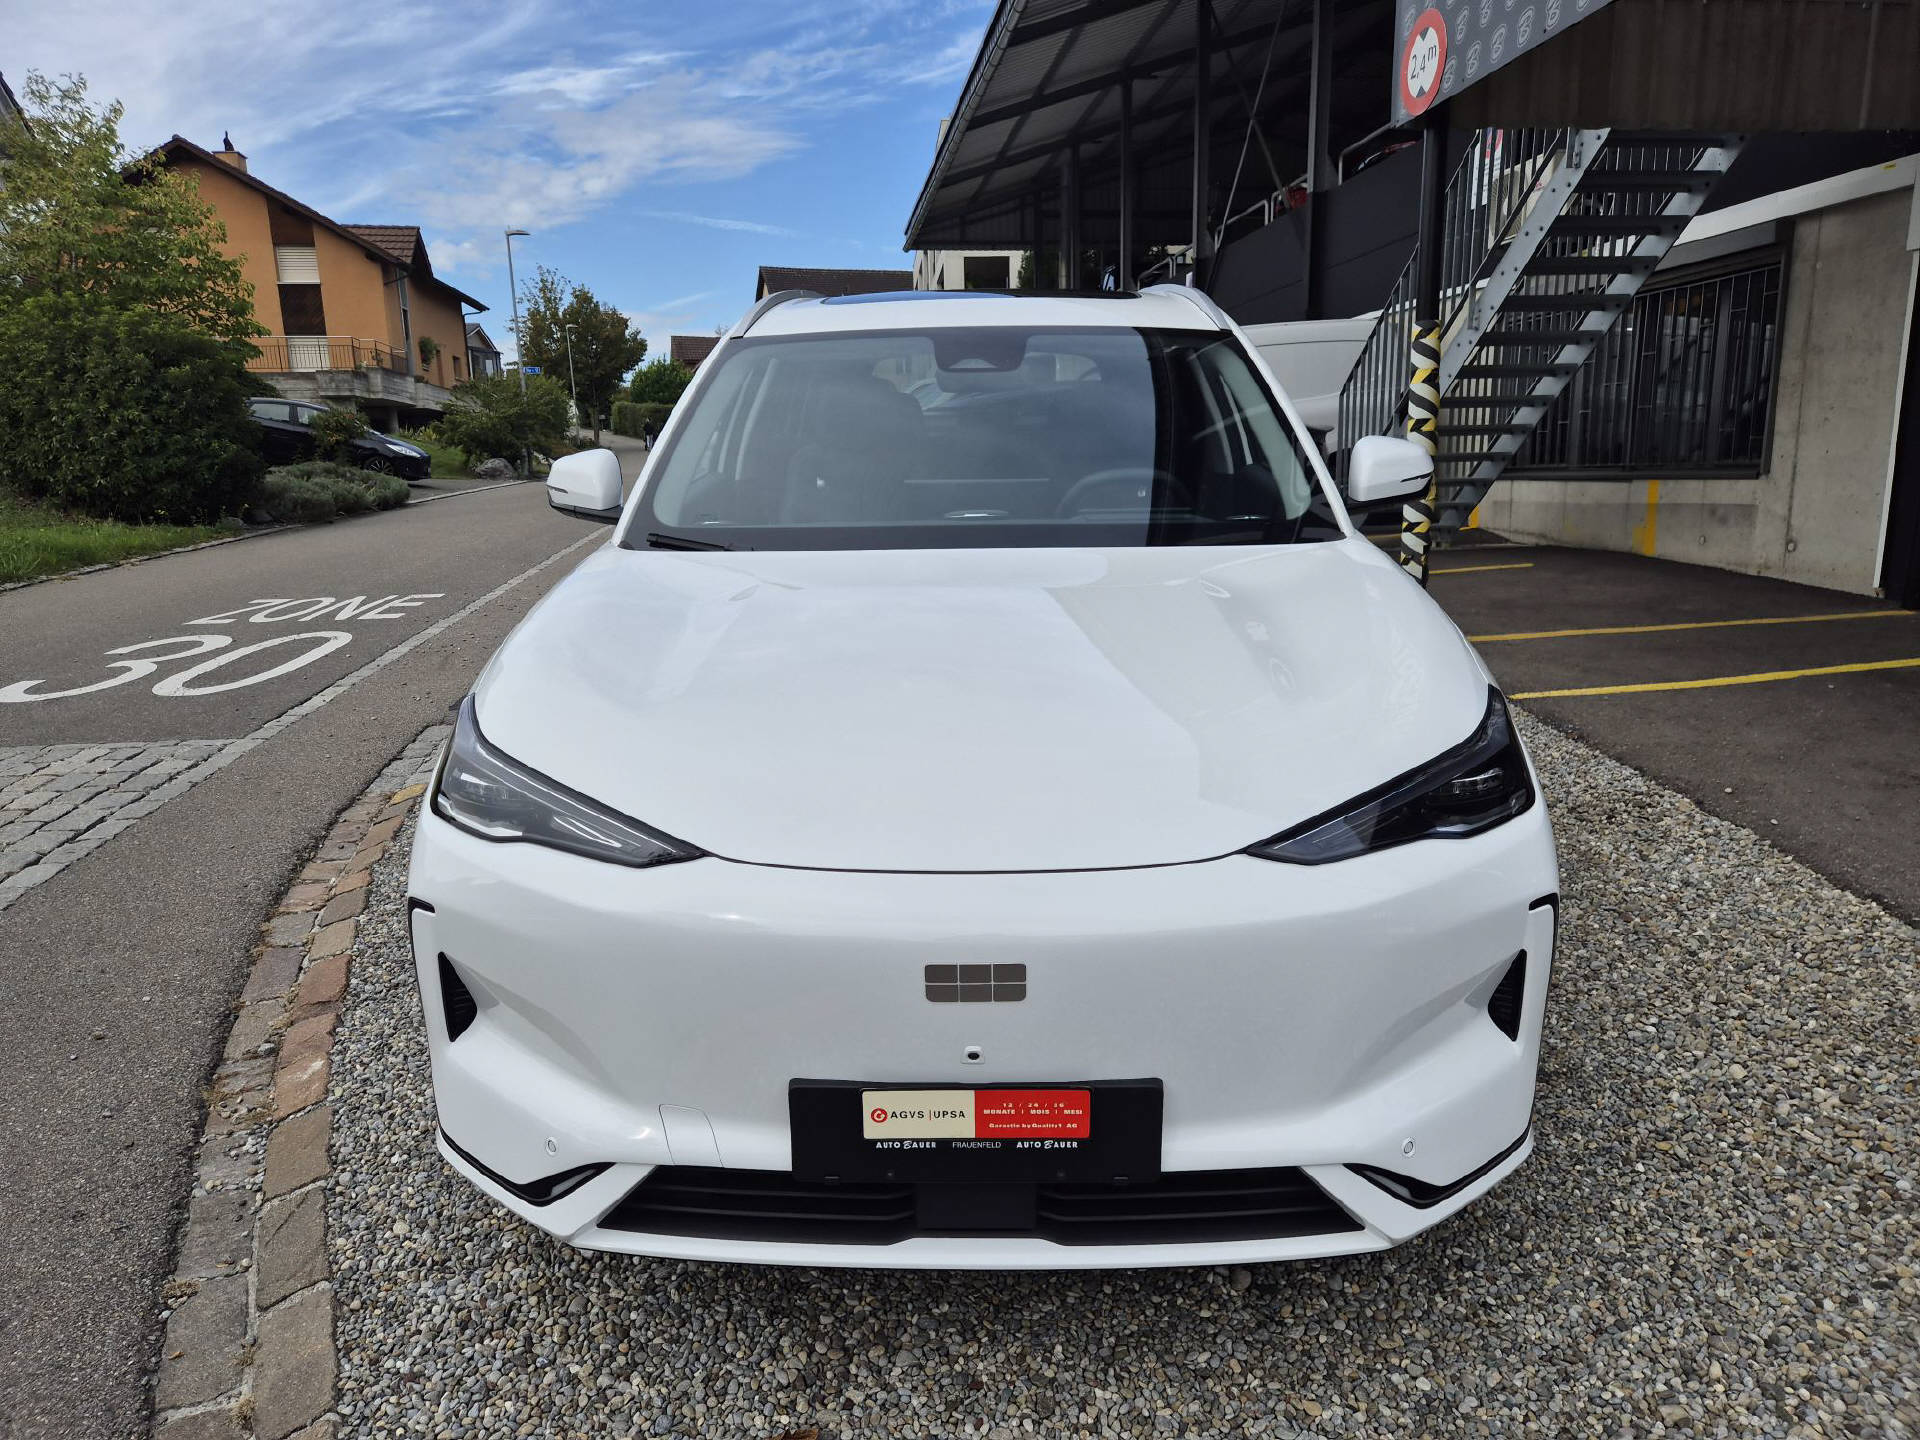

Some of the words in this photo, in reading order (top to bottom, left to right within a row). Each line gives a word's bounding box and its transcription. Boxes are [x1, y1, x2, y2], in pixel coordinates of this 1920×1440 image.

[181, 593, 446, 626] ZONE
[0, 630, 353, 703] 30
[890, 1110, 925, 1119] AGVS
[933, 1110, 966, 1119] UPSA
[876, 1141, 901, 1149] AUTO
[903, 1140, 937, 1149] BAUER
[952, 1141, 1001, 1149] FRAUENFELD
[1016, 1141, 1041, 1149] AUTO
[1043, 1140, 1078, 1149] BAUER
